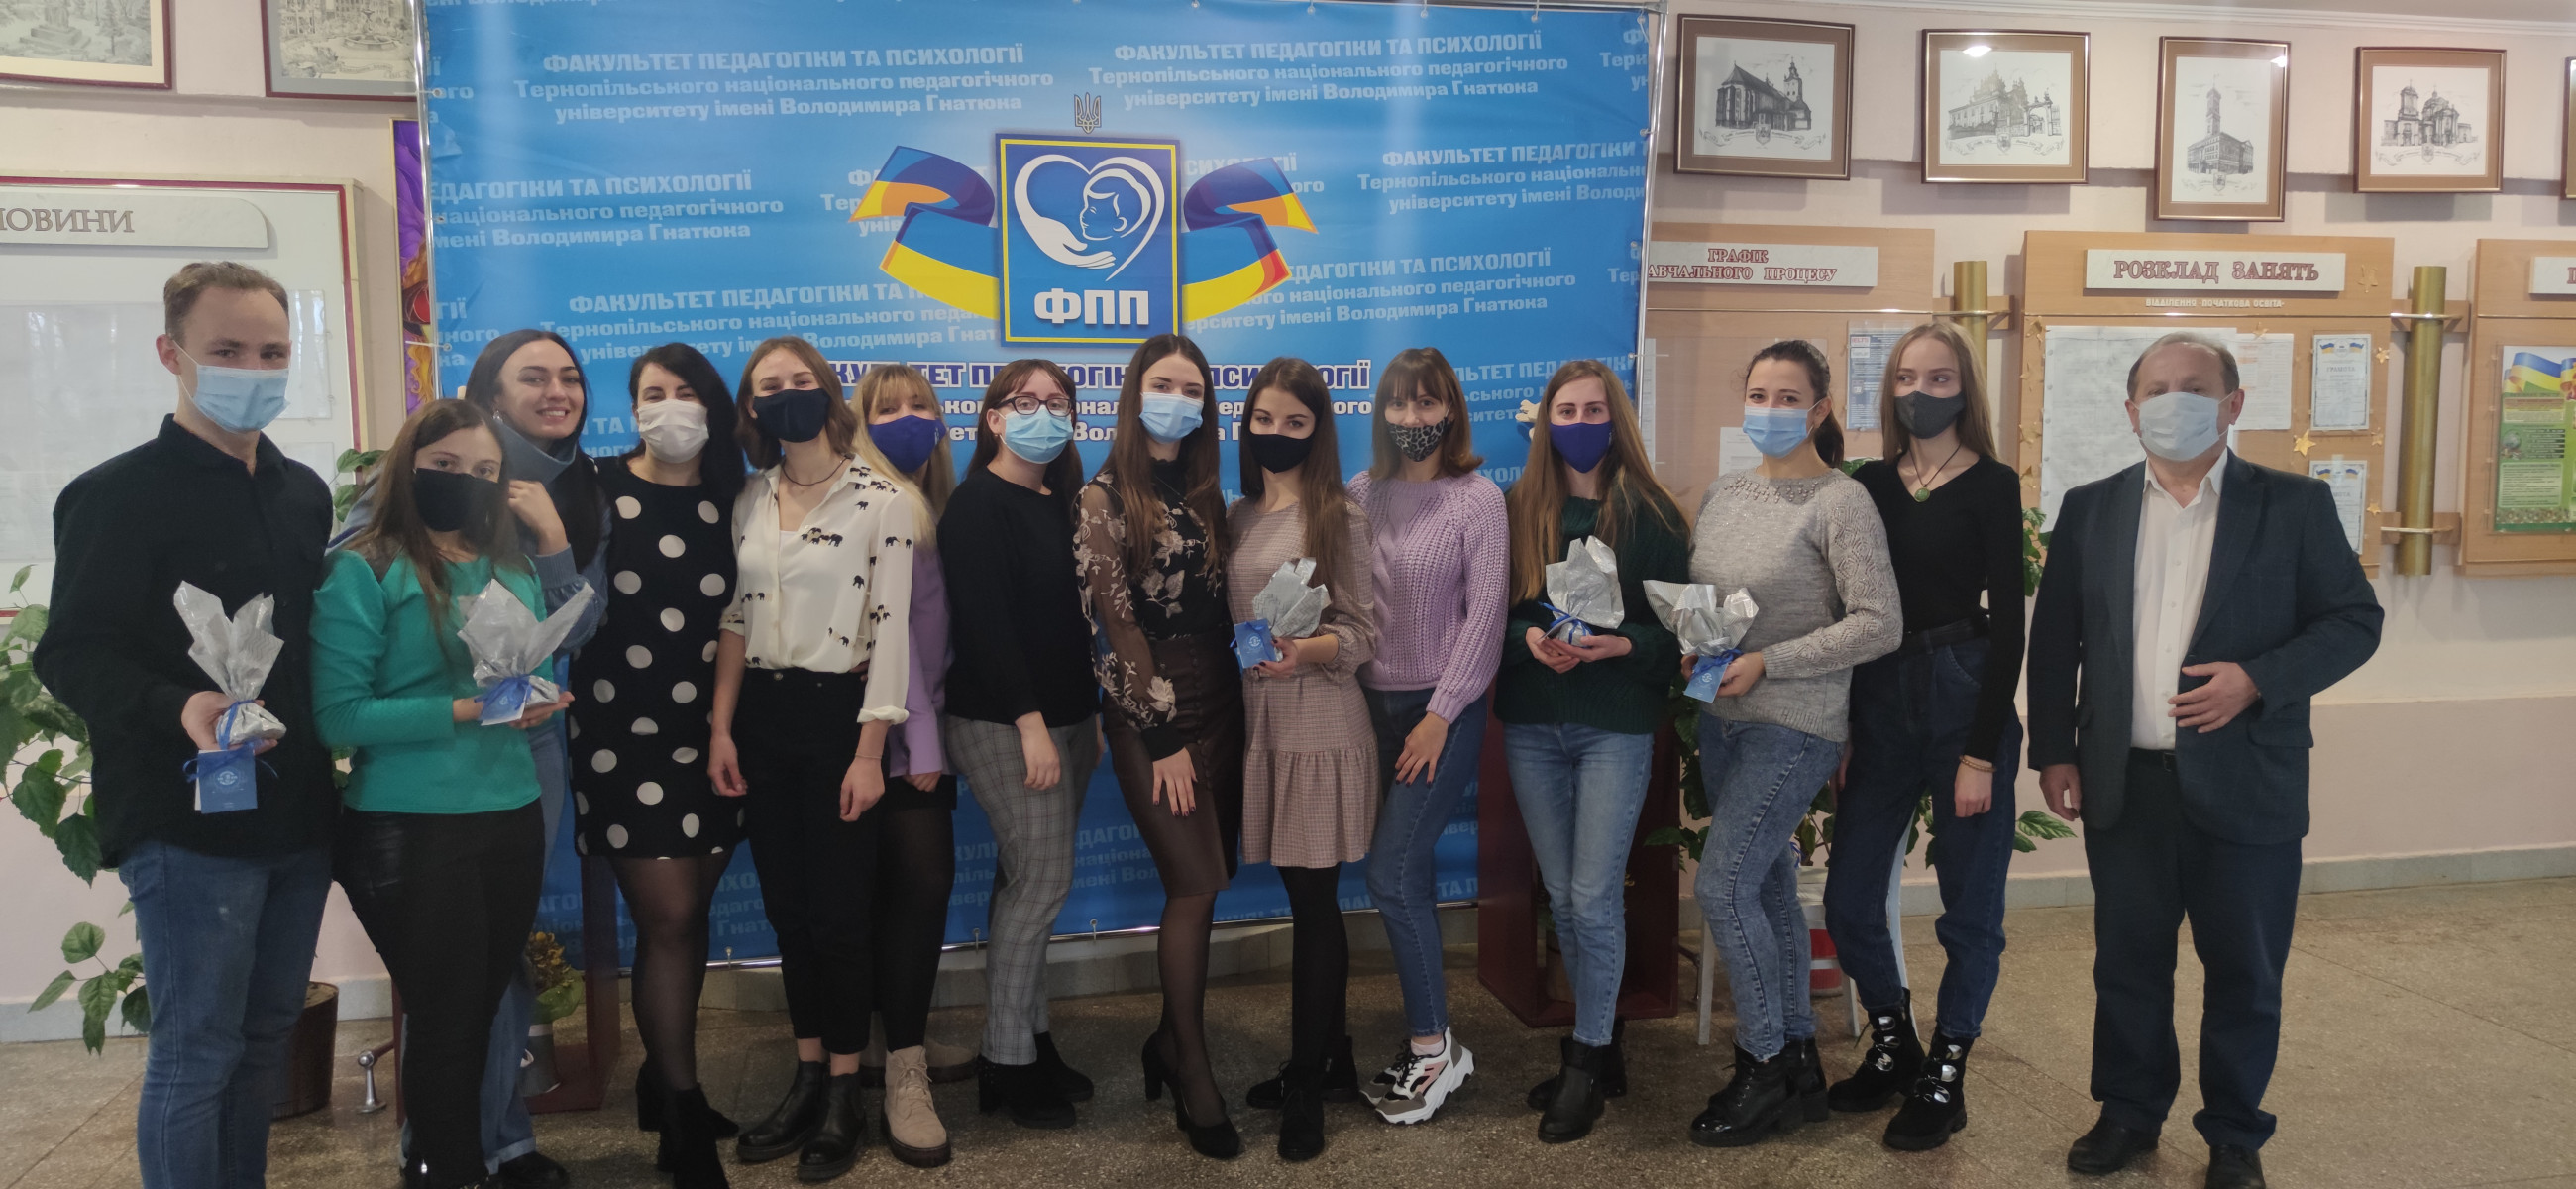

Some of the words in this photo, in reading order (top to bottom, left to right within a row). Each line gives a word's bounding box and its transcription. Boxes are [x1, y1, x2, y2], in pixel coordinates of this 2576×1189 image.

[543, 53, 693, 72] ФАКУЛЬТЕТ
[698, 50, 847, 73] ПЕДАГОГІКИ
[851, 50, 881, 67] ТА
[886, 43, 1024, 67] ПСИХОЛОГІЇ
[1115, 44, 1246, 61] ФАКУЛЬТЕТ
[1251, 40, 1382, 62] ПЕДАГОГІКИ
[1386, 38, 1415, 55] ТА
[1418, 30, 1542, 54] ПСИХОЛОГІЇ
[1088, 65, 1269, 88] Тернопільського
[1274, 63, 1423, 81] національного
[1428, 56, 1568, 78] педагогічного
[513, 79, 719, 101] Тернопільського
[725, 75, 894, 95] національного
[899, 71, 1054, 91] педагогічного
[1124, 90, 1261, 111] університету
[1265, 85, 1319, 102] імені
[1323, 82, 1448, 101] Володимира
[1451, 80, 1538, 96] Гнатюка
[555, 103, 710, 125] університету
[714, 99, 775, 117] імені
[780, 97, 921, 117] Володимира
[925, 95, 1022, 112] Гнатюка
[1382, 146, 1507, 166] ФАКУЛЬТЕТ
[1511, 140, 1636, 164] ПЕДАГОГІКИ
[569, 178, 600, 196] ТА
[605, 169, 752, 195] ПСИХОЛОГІЇ
[1357, 171, 1526, 193] Тернопільського
[620, 198, 784, 221] педагогічного
[1389, 192, 1518, 214] університету
[1522, 186, 1571, 204] імені
[492, 227, 643, 247] Володимира
[649, 223, 751, 242] Гнатюка
[1400, 258, 1426, 275] ТА
[1431, 248, 1551, 273] ПСИХОЛОГІЇ
[1707, 248, 1770, 264] ГРАФІК
[1649, 264, 1754, 280] АВЧАЛЬНОГО
[1764, 267, 1838, 284] ПРОЦЕСУ
[2113, 260, 2220, 284] РОЗКЛАД
[2231, 261, 2319, 281] ЗАНЯТЬ
[569, 289, 716, 313] ФАКУЛЬТЕТ
[721, 284, 869, 309] ПЕДАГОГІКИ
[873, 282, 904, 300] ТА
[1289, 281, 1436, 304] національного
[1441, 273, 1576, 296] педагогічного
[748, 306, 915, 331] національного
[1033, 287, 1149, 325] ФПП
[1280, 307, 1332, 325] імені
[1337, 300, 1458, 321] Володимира
[1463, 295, 1548, 314] Гнатюка
[592, 416, 626, 435] ТА
